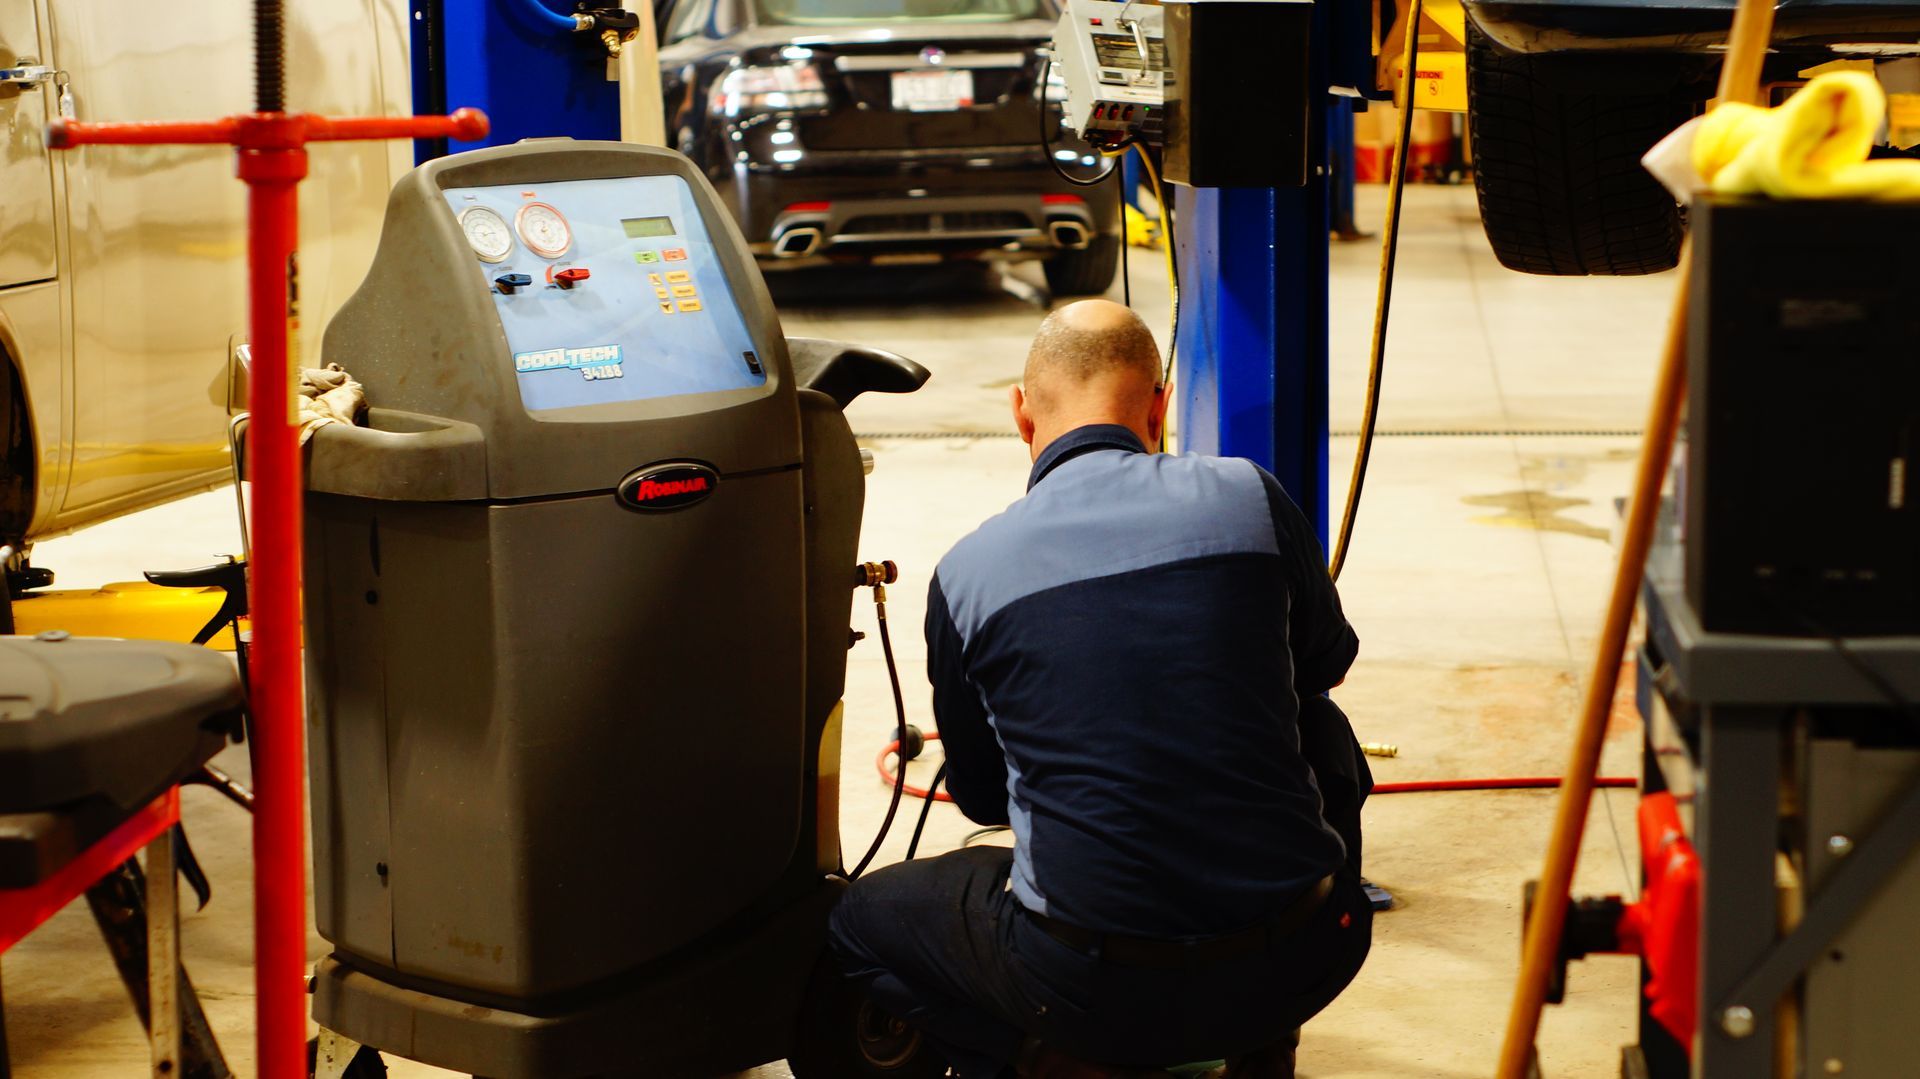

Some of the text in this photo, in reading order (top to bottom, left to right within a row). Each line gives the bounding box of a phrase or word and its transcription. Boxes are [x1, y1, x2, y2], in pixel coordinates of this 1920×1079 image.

[1400, 71, 1440, 79] UTION
[517, 345, 618, 369] COOLTECH
[638, 477, 706, 501] ROBINAIR
